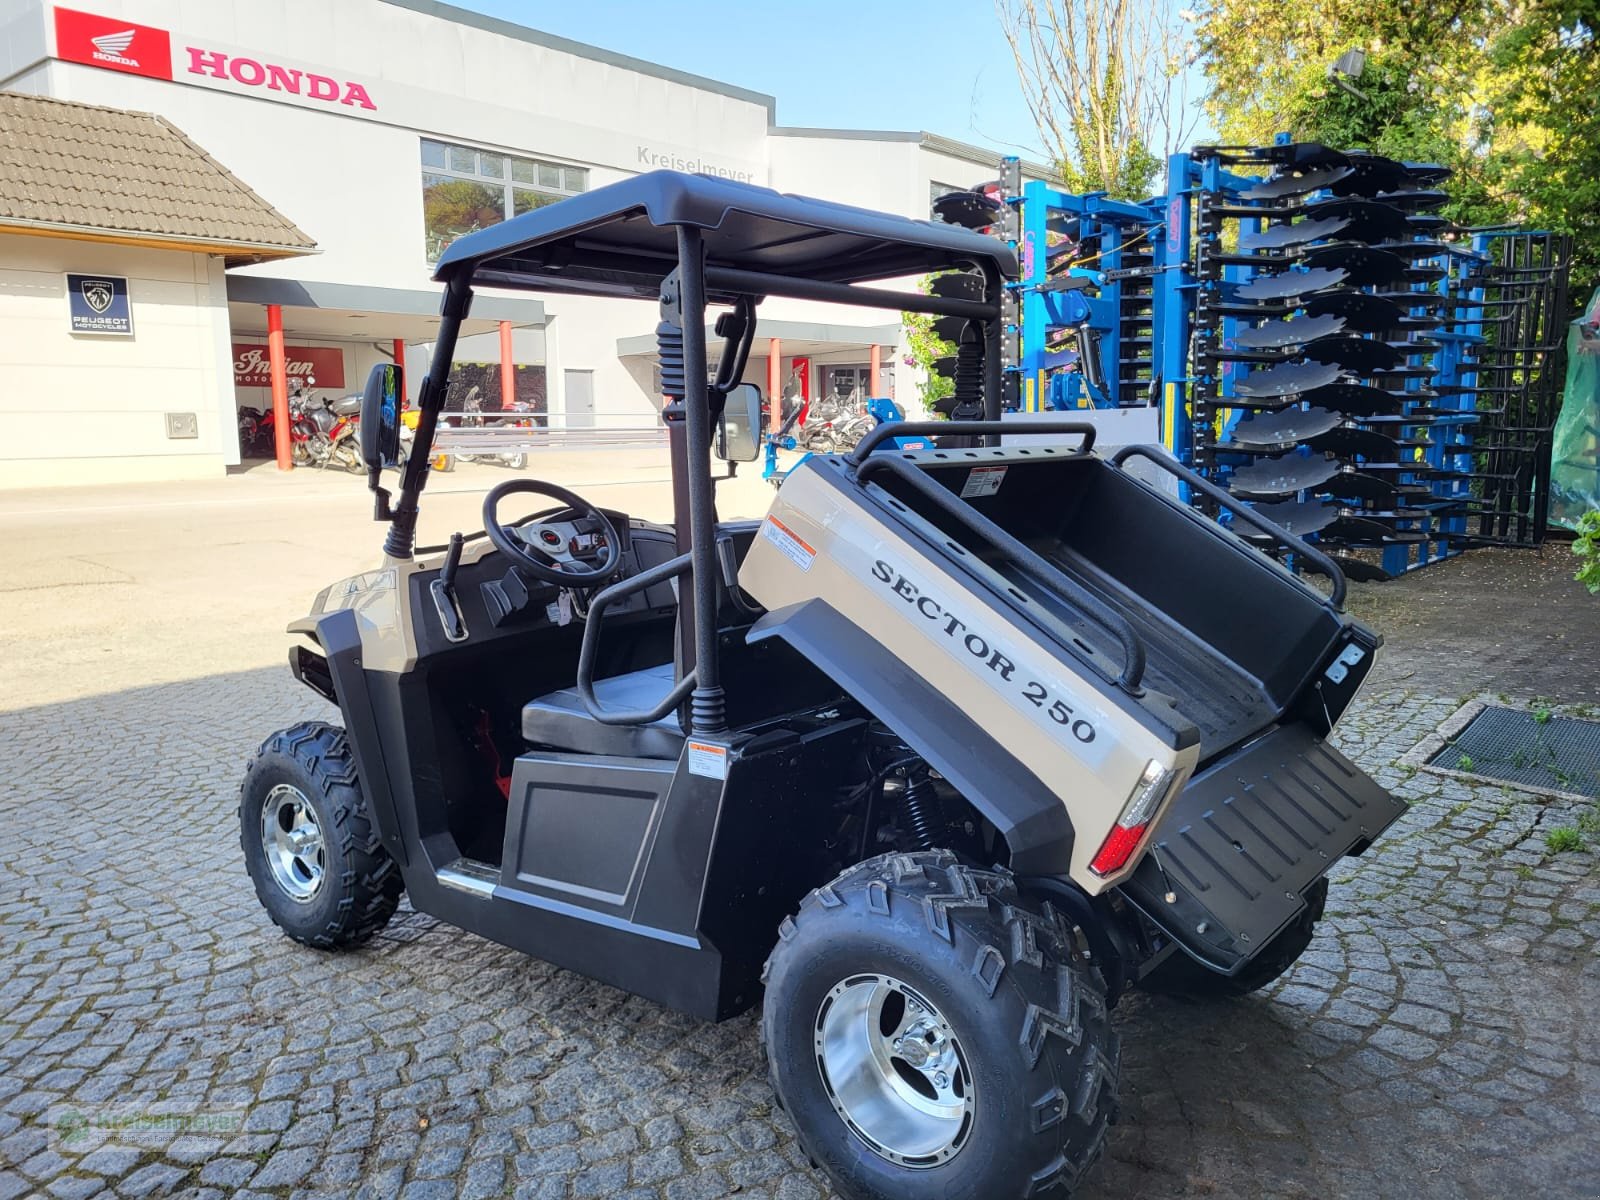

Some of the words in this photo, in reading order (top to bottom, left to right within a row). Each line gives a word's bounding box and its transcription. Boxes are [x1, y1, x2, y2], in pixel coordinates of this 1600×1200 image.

[92, 51, 141, 68] HONDA
[186, 46, 378, 111] HONDA
[637, 146, 753, 184] Kreiselmeyer
[73, 317, 127, 325] PEUGEOT
[233, 349, 316, 375] Inian
[871, 559, 1016, 682] SECTOR
[1021, 681, 1097, 744] 250
